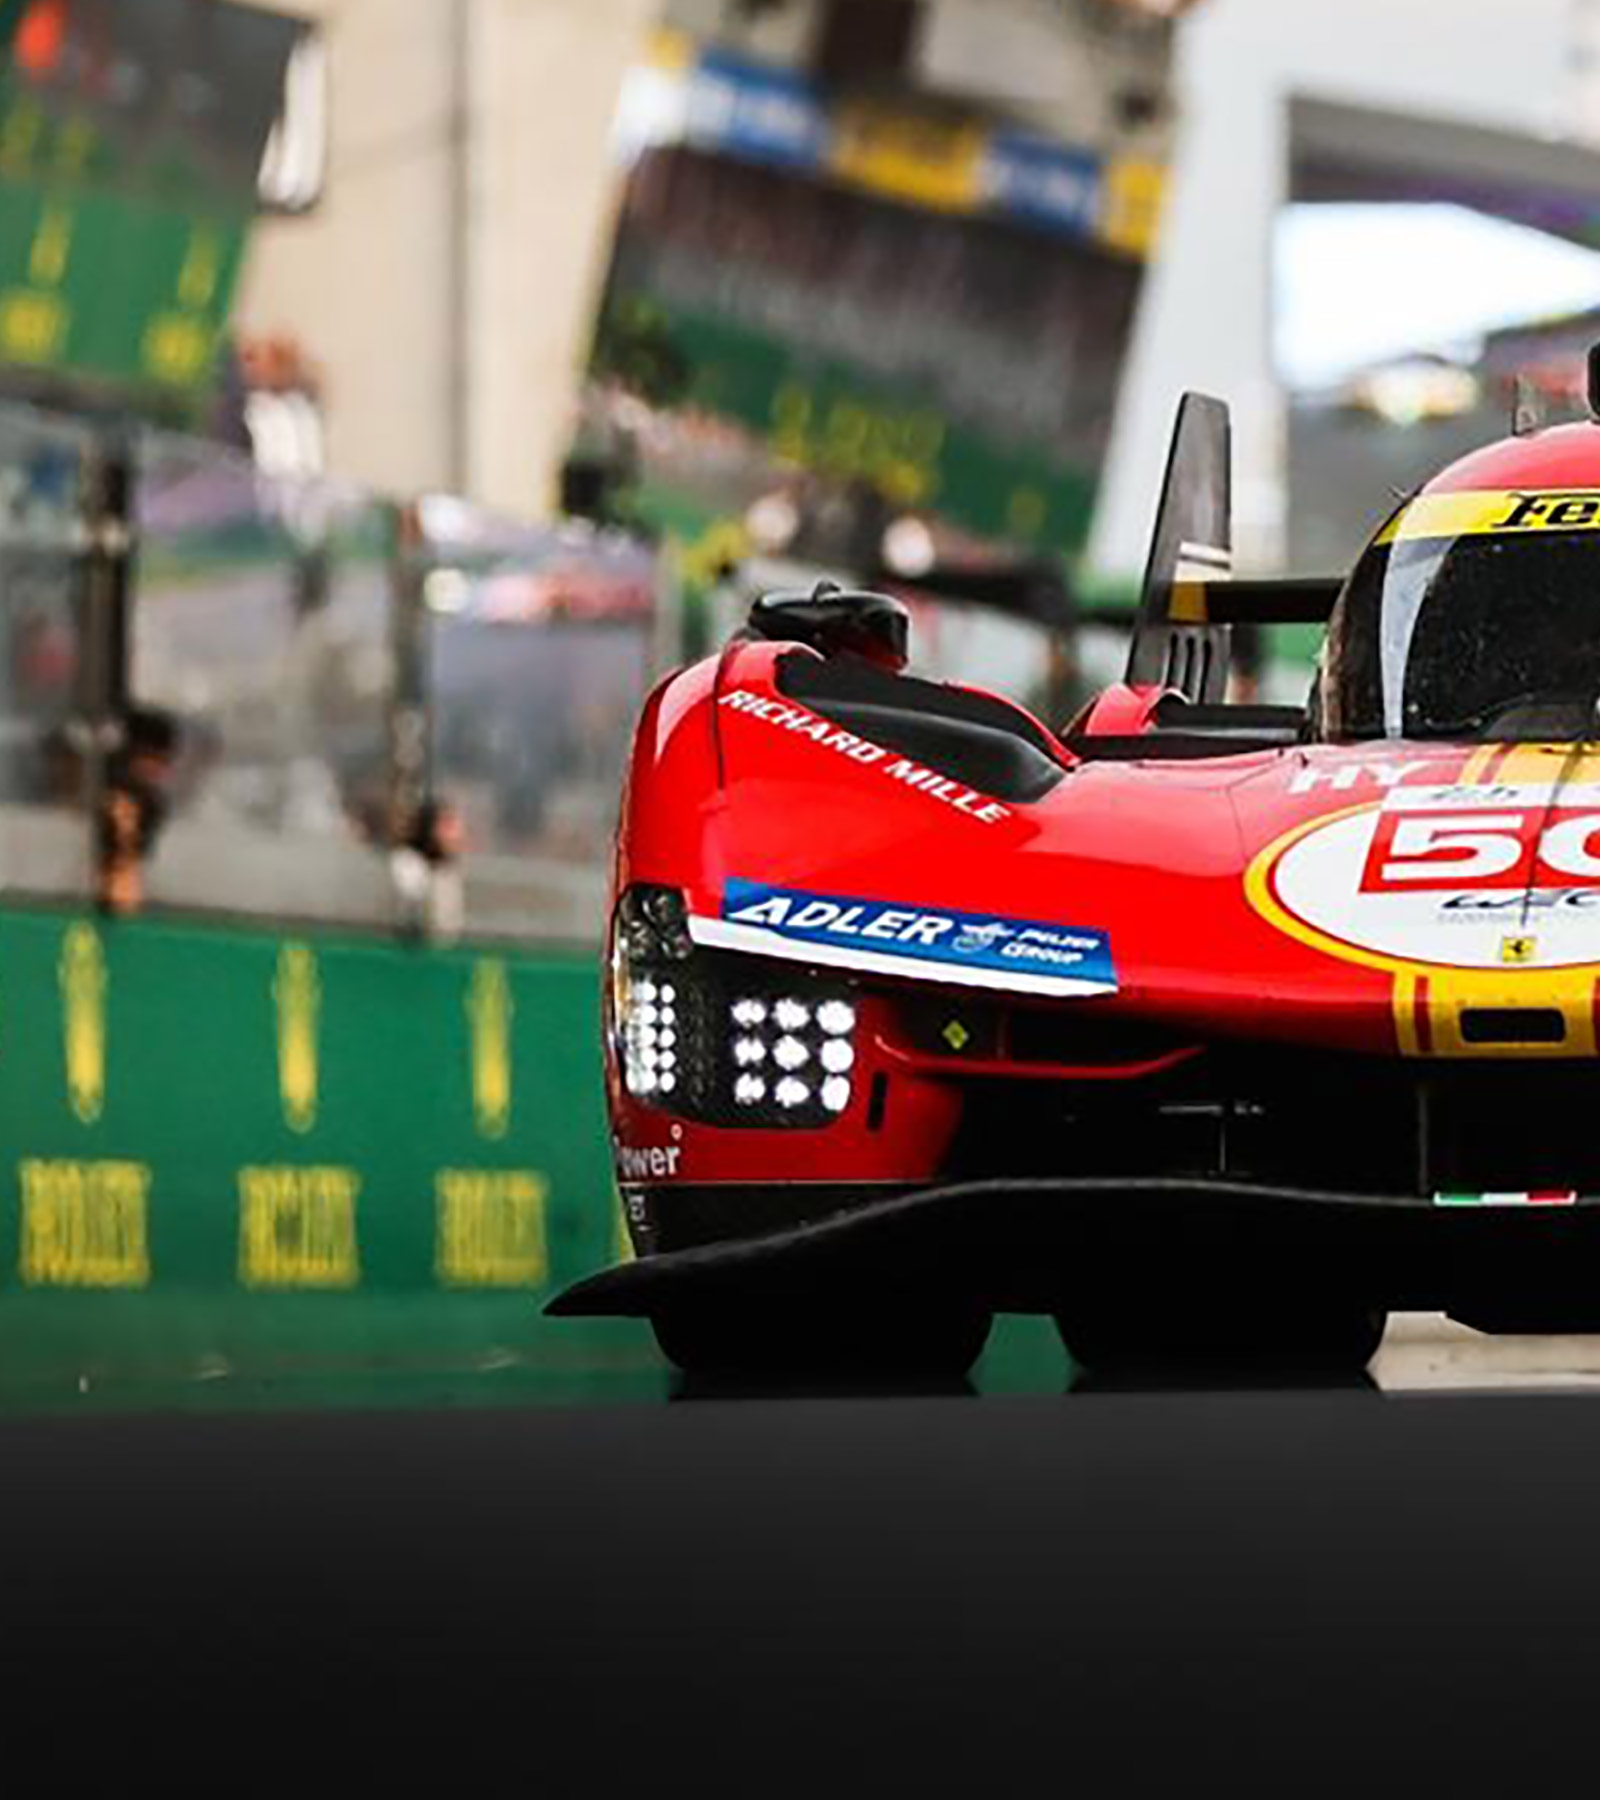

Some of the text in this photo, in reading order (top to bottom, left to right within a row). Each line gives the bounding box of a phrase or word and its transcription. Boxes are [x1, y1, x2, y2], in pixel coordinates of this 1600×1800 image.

[717, 689, 1012, 824] RICHARD MILLE
[727, 896, 954, 945] ADLER
